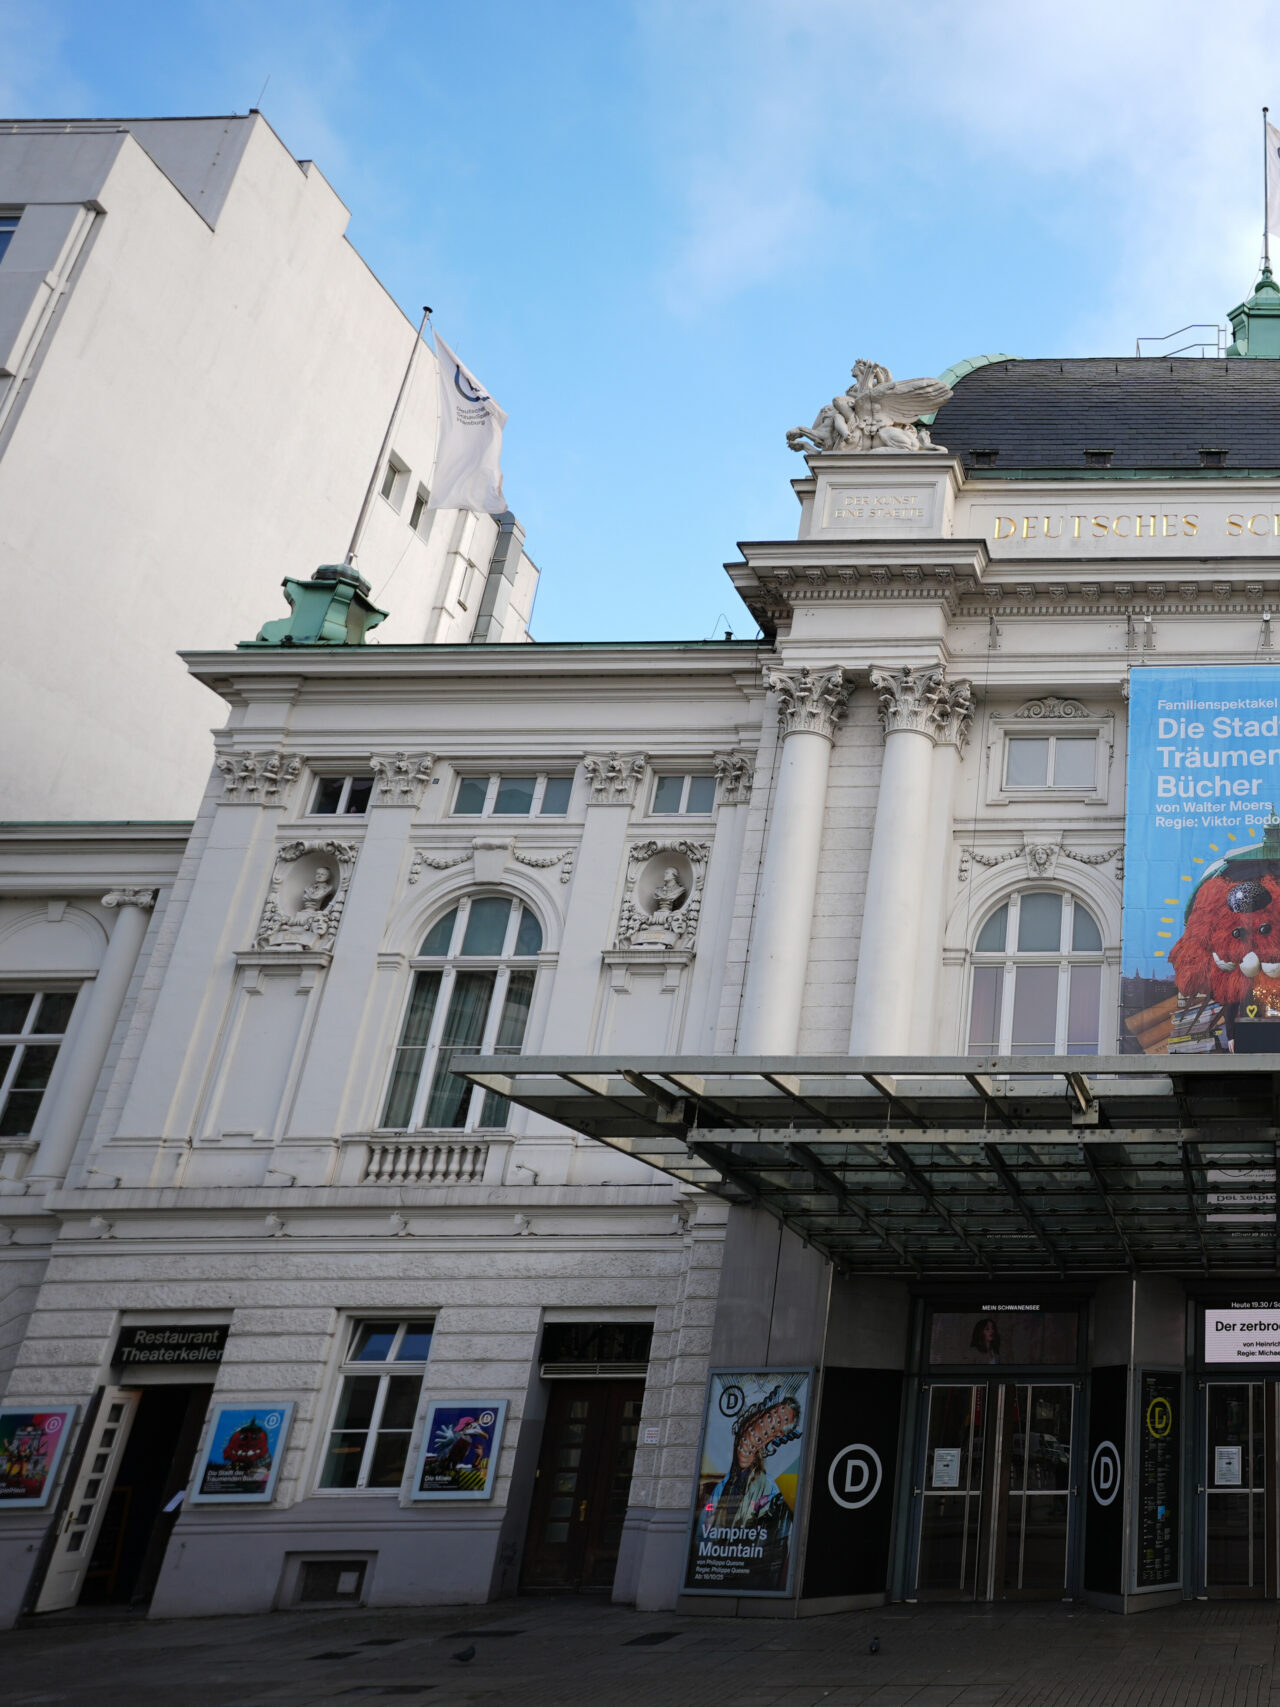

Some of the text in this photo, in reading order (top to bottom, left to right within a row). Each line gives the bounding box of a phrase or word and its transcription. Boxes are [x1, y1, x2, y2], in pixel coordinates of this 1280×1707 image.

[844, 495, 918, 505] DER KUNST
[834, 507, 924, 518] EINE STAETTE
[992, 514, 1200, 540] DEUTSCHES
[1157, 698, 1278, 711] Familienspektakel
[1157, 717, 1205, 739] Die
[1157, 775, 1263, 797] Bücher
[1156, 800, 1273, 812] von Walter Moers
[1155, 813, 1280, 829] Regie: Viktor Bodo
[1215, 1320, 1237, 1331] Der
[133, 1329, 221, 1345] Restaurant
[120, 1346, 224, 1362] Theaterkeller
[698, 1541, 764, 1559] Mountain
